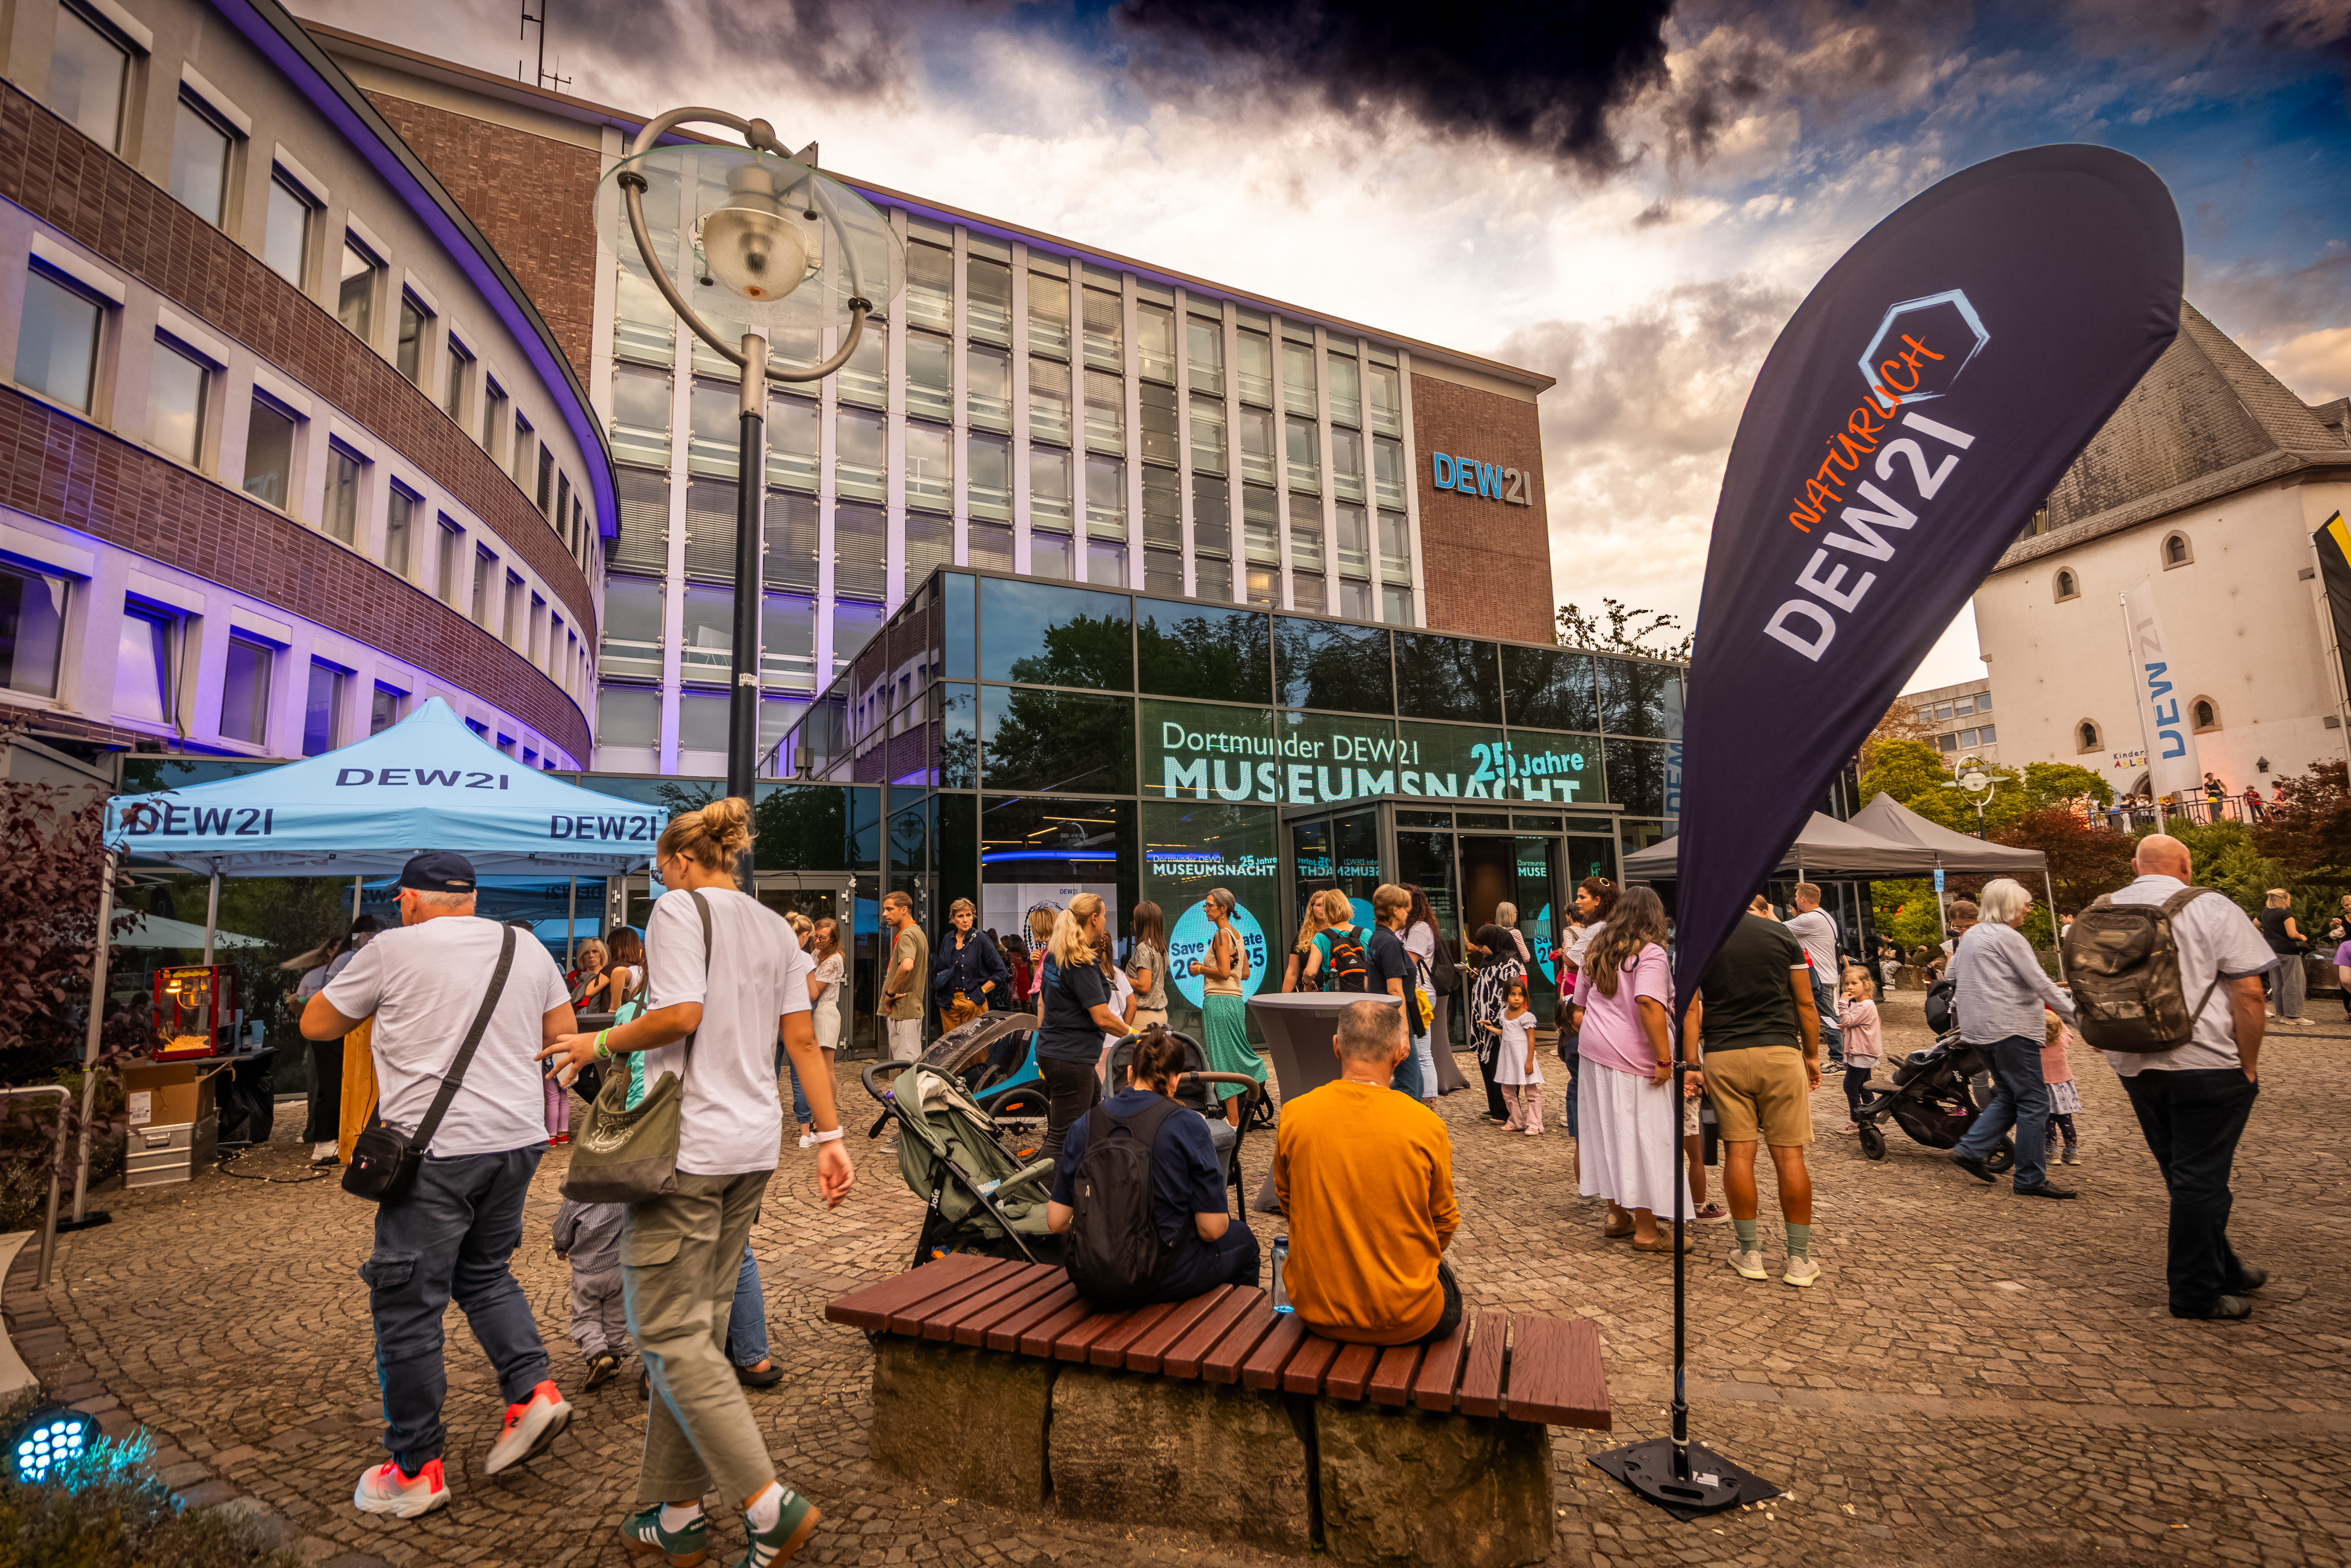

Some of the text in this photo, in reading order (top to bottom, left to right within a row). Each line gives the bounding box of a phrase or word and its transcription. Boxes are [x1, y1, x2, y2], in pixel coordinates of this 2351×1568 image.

[1789, 334, 1944, 532] NATÜRLICH
[1433, 452, 1532, 506] DEW21
[1764, 412, 1975, 662] DEW21
[2136, 617, 2186, 760] DEW21
[1163, 721, 1419, 765] Dortmunder DEW21
[2113, 750, 2144, 759] Kinder
[1471, 741, 1584, 782] 25 Jahre
[336, 768, 508, 790] DEW21
[1164, 756, 1580, 804] MUSEUMSNACHT
[129, 806, 274, 835] DEW21
[551, 816, 656, 841] DEW21
[1153, 863, 1276, 876] MUSEUMSNACHT
[1240, 855, 1277, 867] 25 Jahre
[1171, 942, 1205, 956] Save
[1243, 933, 1262, 946] ate
[1952, 1070, 1963, 1082] Joie
[930, 1188, 940, 1209] Joie
